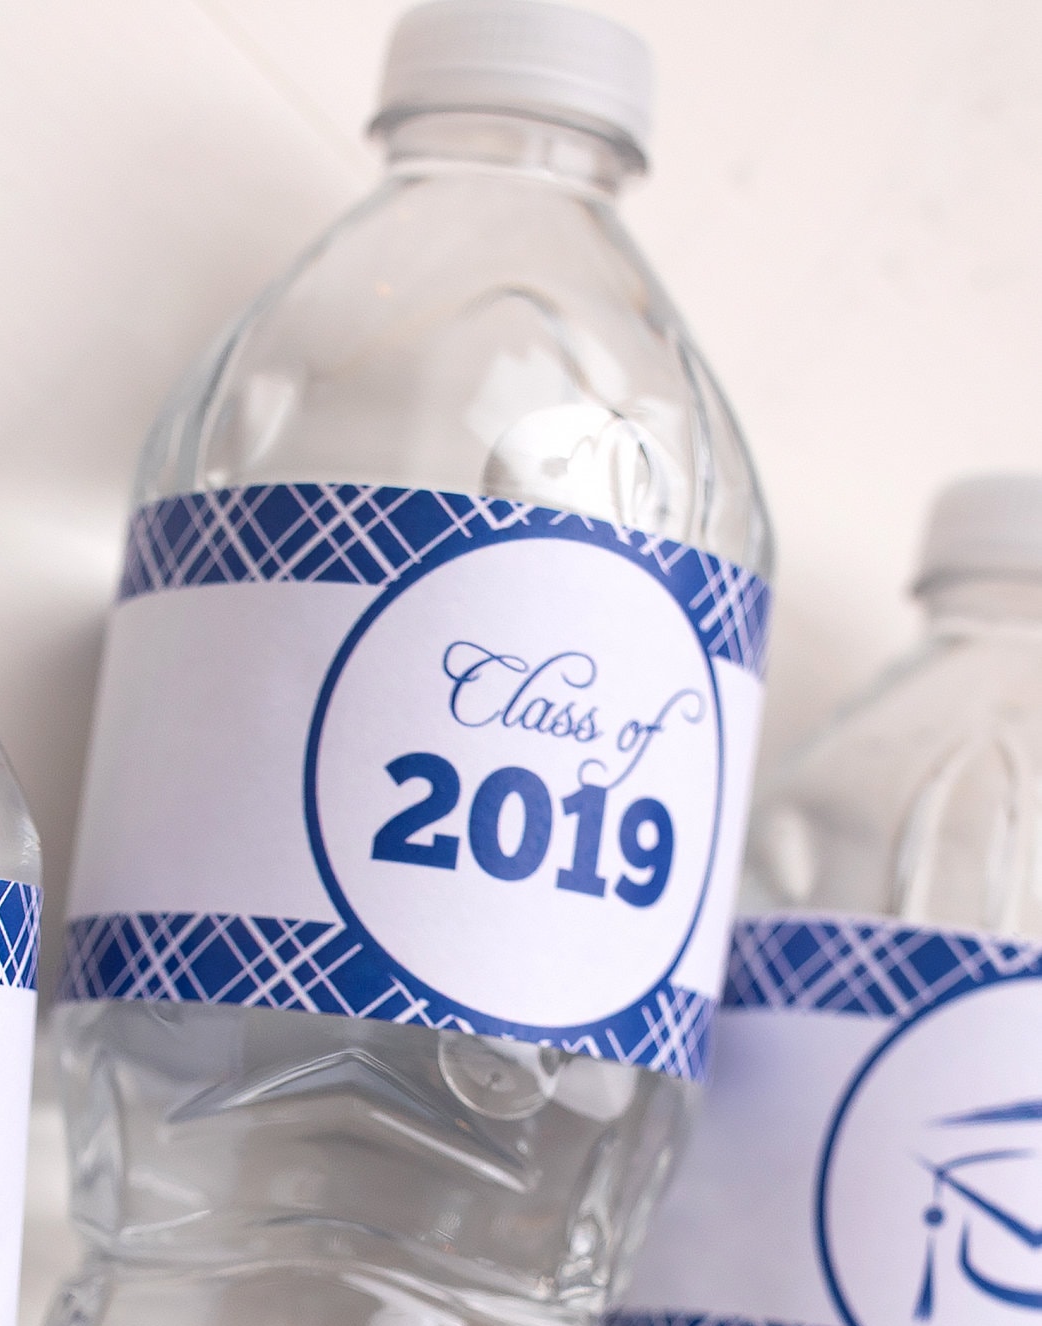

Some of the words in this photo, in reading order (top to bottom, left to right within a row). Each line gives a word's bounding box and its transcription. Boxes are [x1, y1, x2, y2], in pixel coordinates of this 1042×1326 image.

[443, 640, 598, 744] Class
[576, 687, 707, 792] of
[370, 751, 676, 910] 2019
